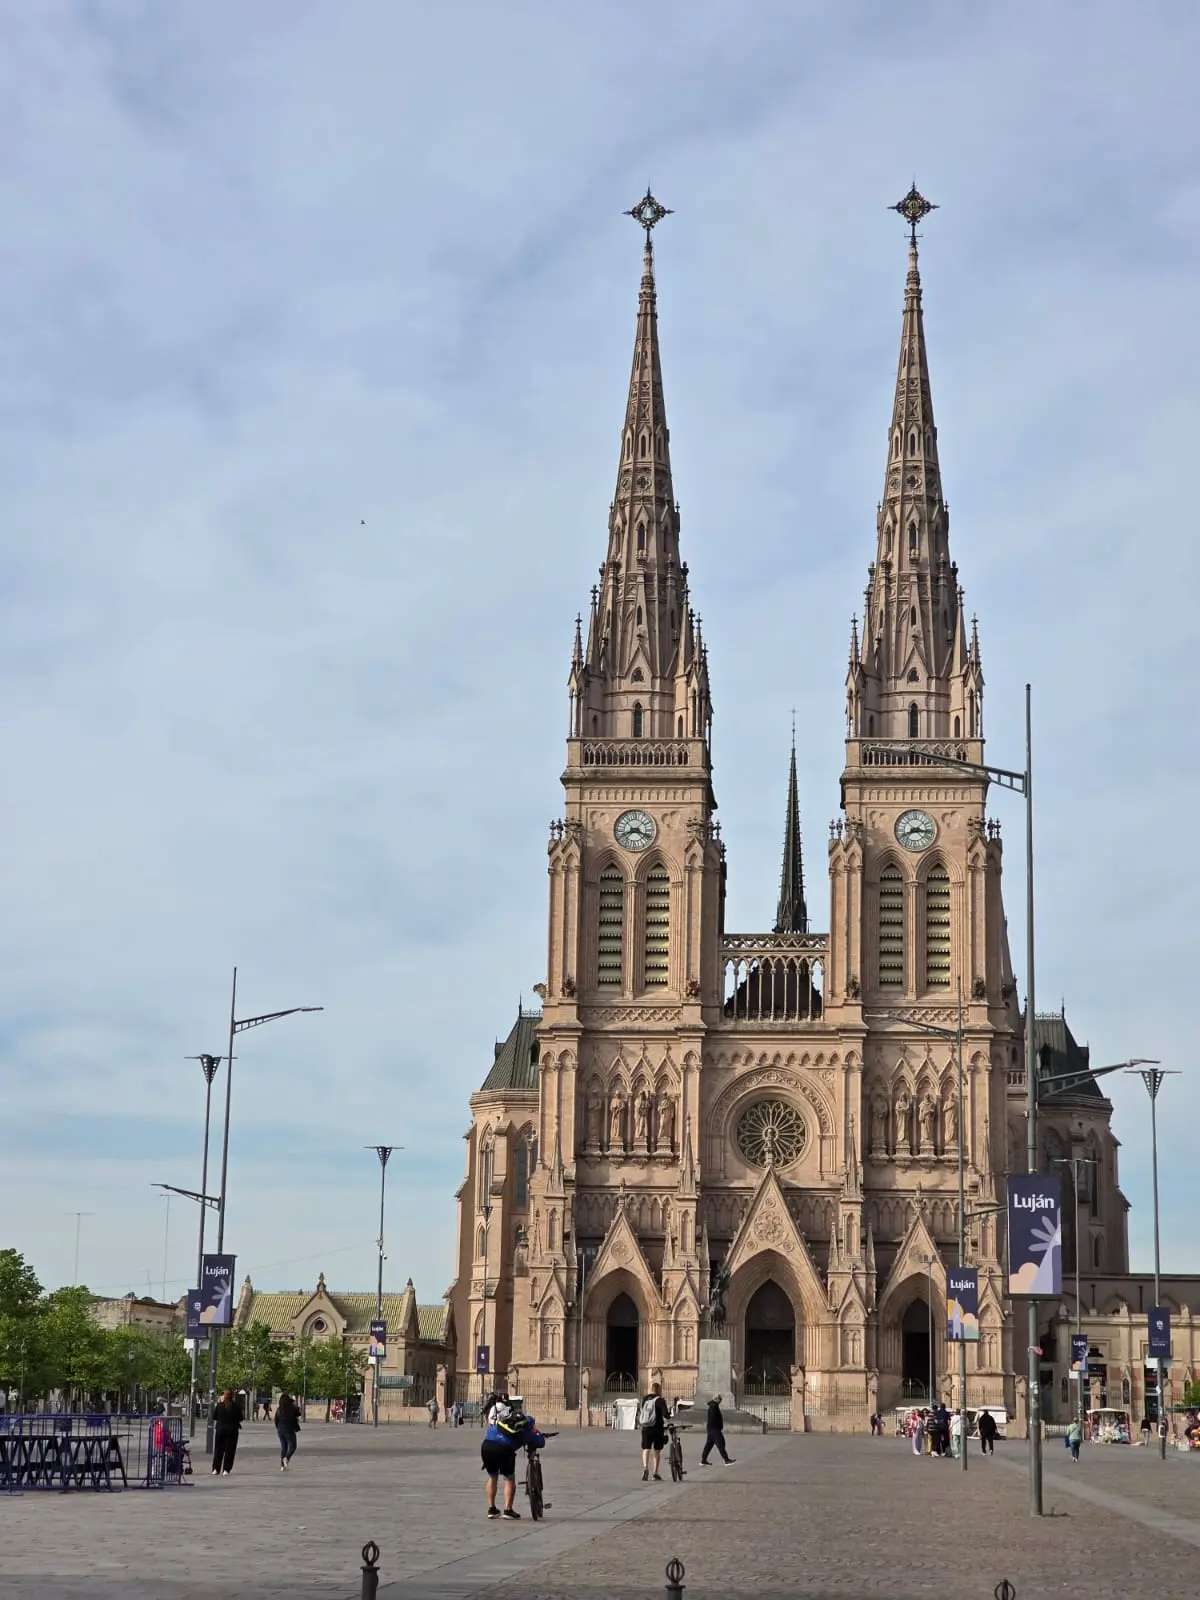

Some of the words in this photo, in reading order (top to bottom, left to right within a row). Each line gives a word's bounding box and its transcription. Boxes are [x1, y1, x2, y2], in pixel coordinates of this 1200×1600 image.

[1013, 1193, 1055, 1212] Luján
[205, 1266, 229, 1277] Luján
[950, 1279, 975, 1291] Luján
